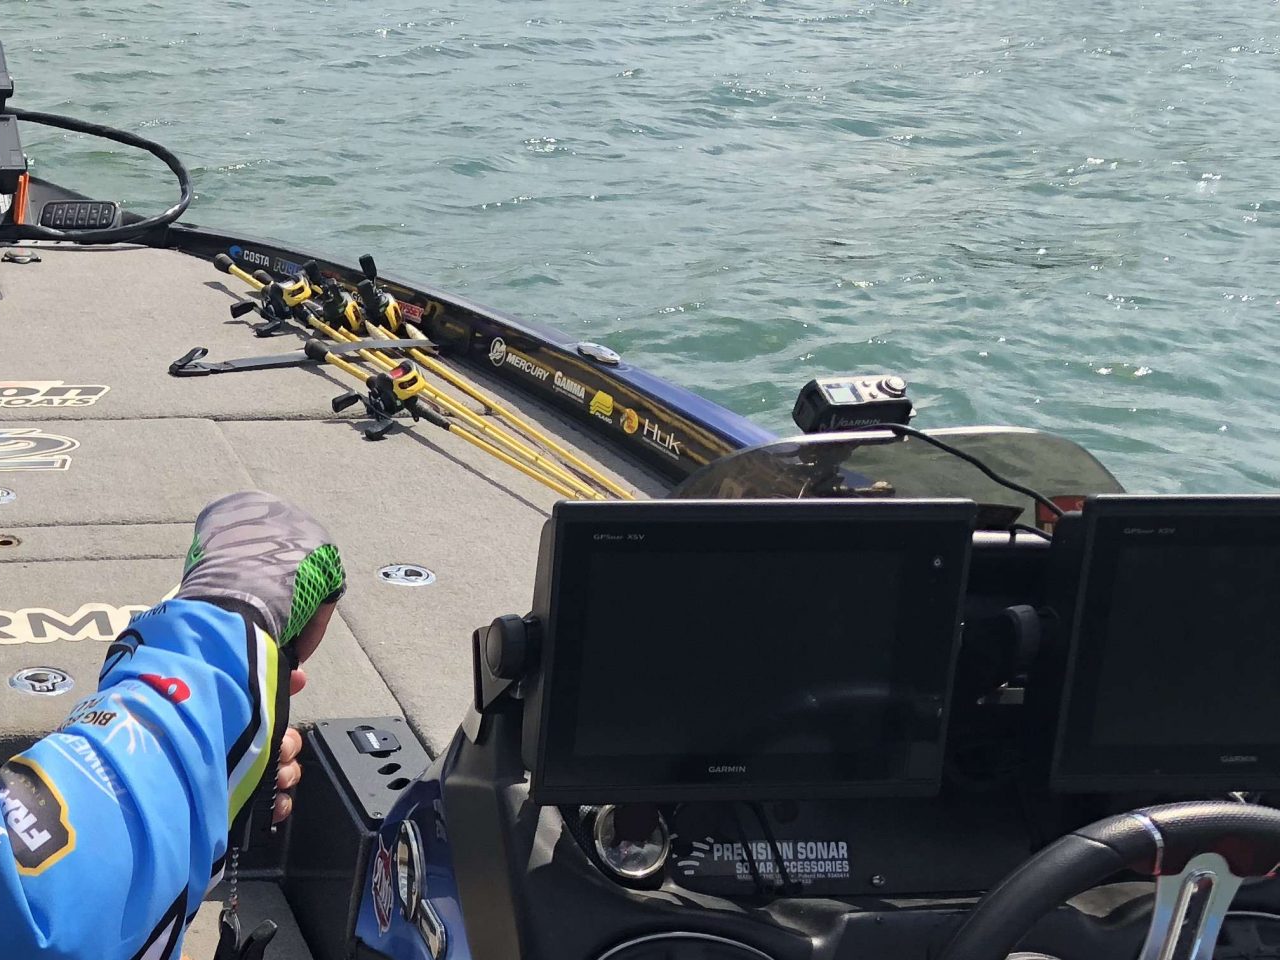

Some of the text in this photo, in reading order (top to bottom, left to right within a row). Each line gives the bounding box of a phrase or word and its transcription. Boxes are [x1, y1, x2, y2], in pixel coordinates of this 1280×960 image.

[243, 250, 269, 267] COSTA
[506, 353, 549, 381] MERCURY
[554, 371, 586, 400] GAMMA
[841, 418, 882, 428] GARMIN
[643, 418, 681, 455] Huk
[708, 765, 747, 773] GARMIN
[797, 841, 848, 860] SONAR
